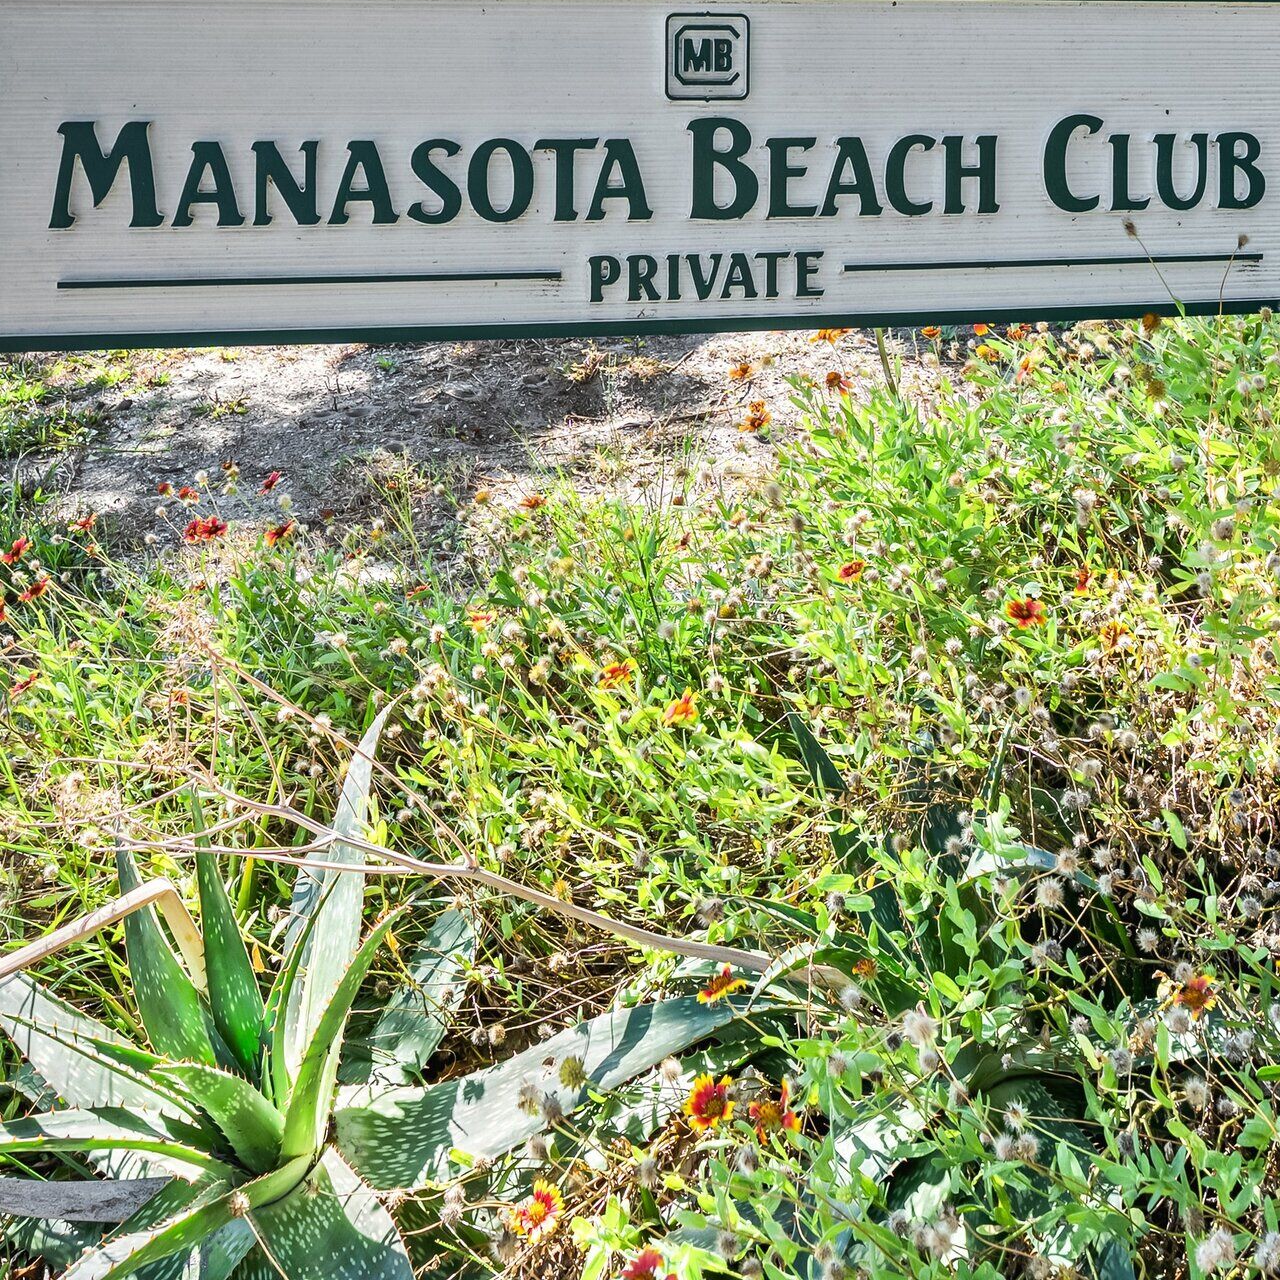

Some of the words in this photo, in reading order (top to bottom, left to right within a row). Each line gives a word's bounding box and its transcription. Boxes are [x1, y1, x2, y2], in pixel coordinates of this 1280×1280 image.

[46, 119, 656, 230] MANASOTA
[685, 113, 1002, 222] BEACH
[1042, 112, 1268, 214] CLUB
[586, 249, 827, 304] PRIVATE
